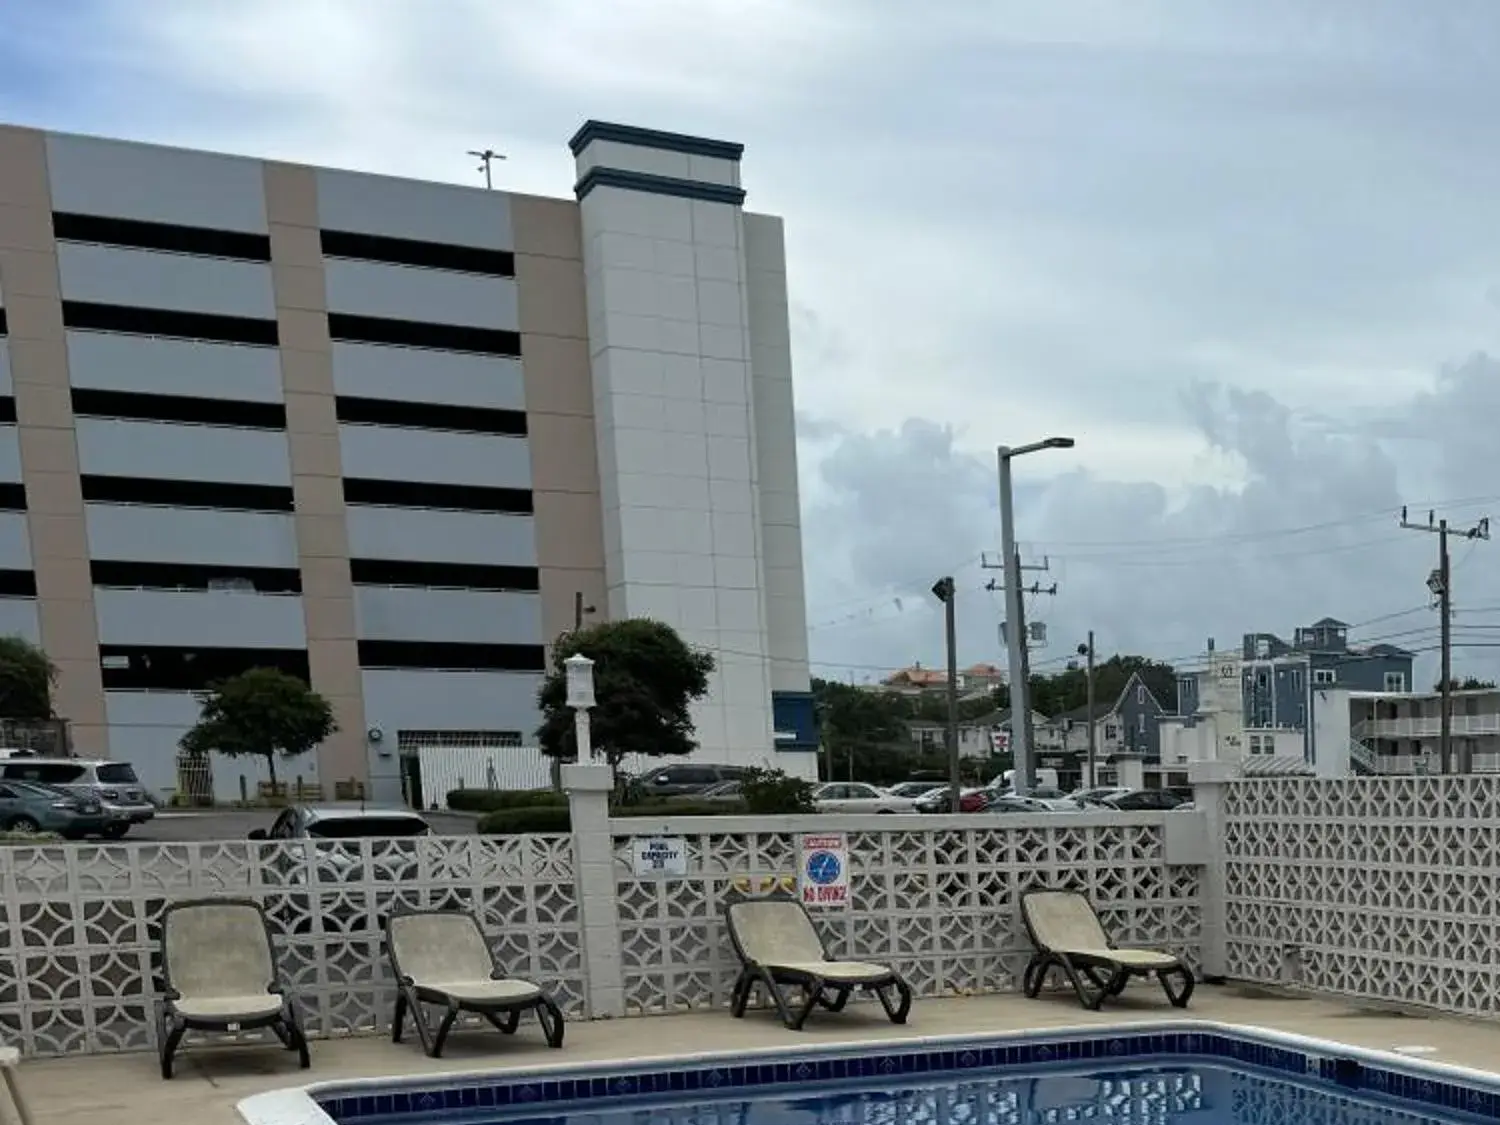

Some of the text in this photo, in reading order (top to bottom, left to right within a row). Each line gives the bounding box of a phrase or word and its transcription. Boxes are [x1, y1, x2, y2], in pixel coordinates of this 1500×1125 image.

[641, 851, 678, 860] CAPACITY
[803, 887, 815, 902] NO
[818, 886, 846, 901] DIVING
